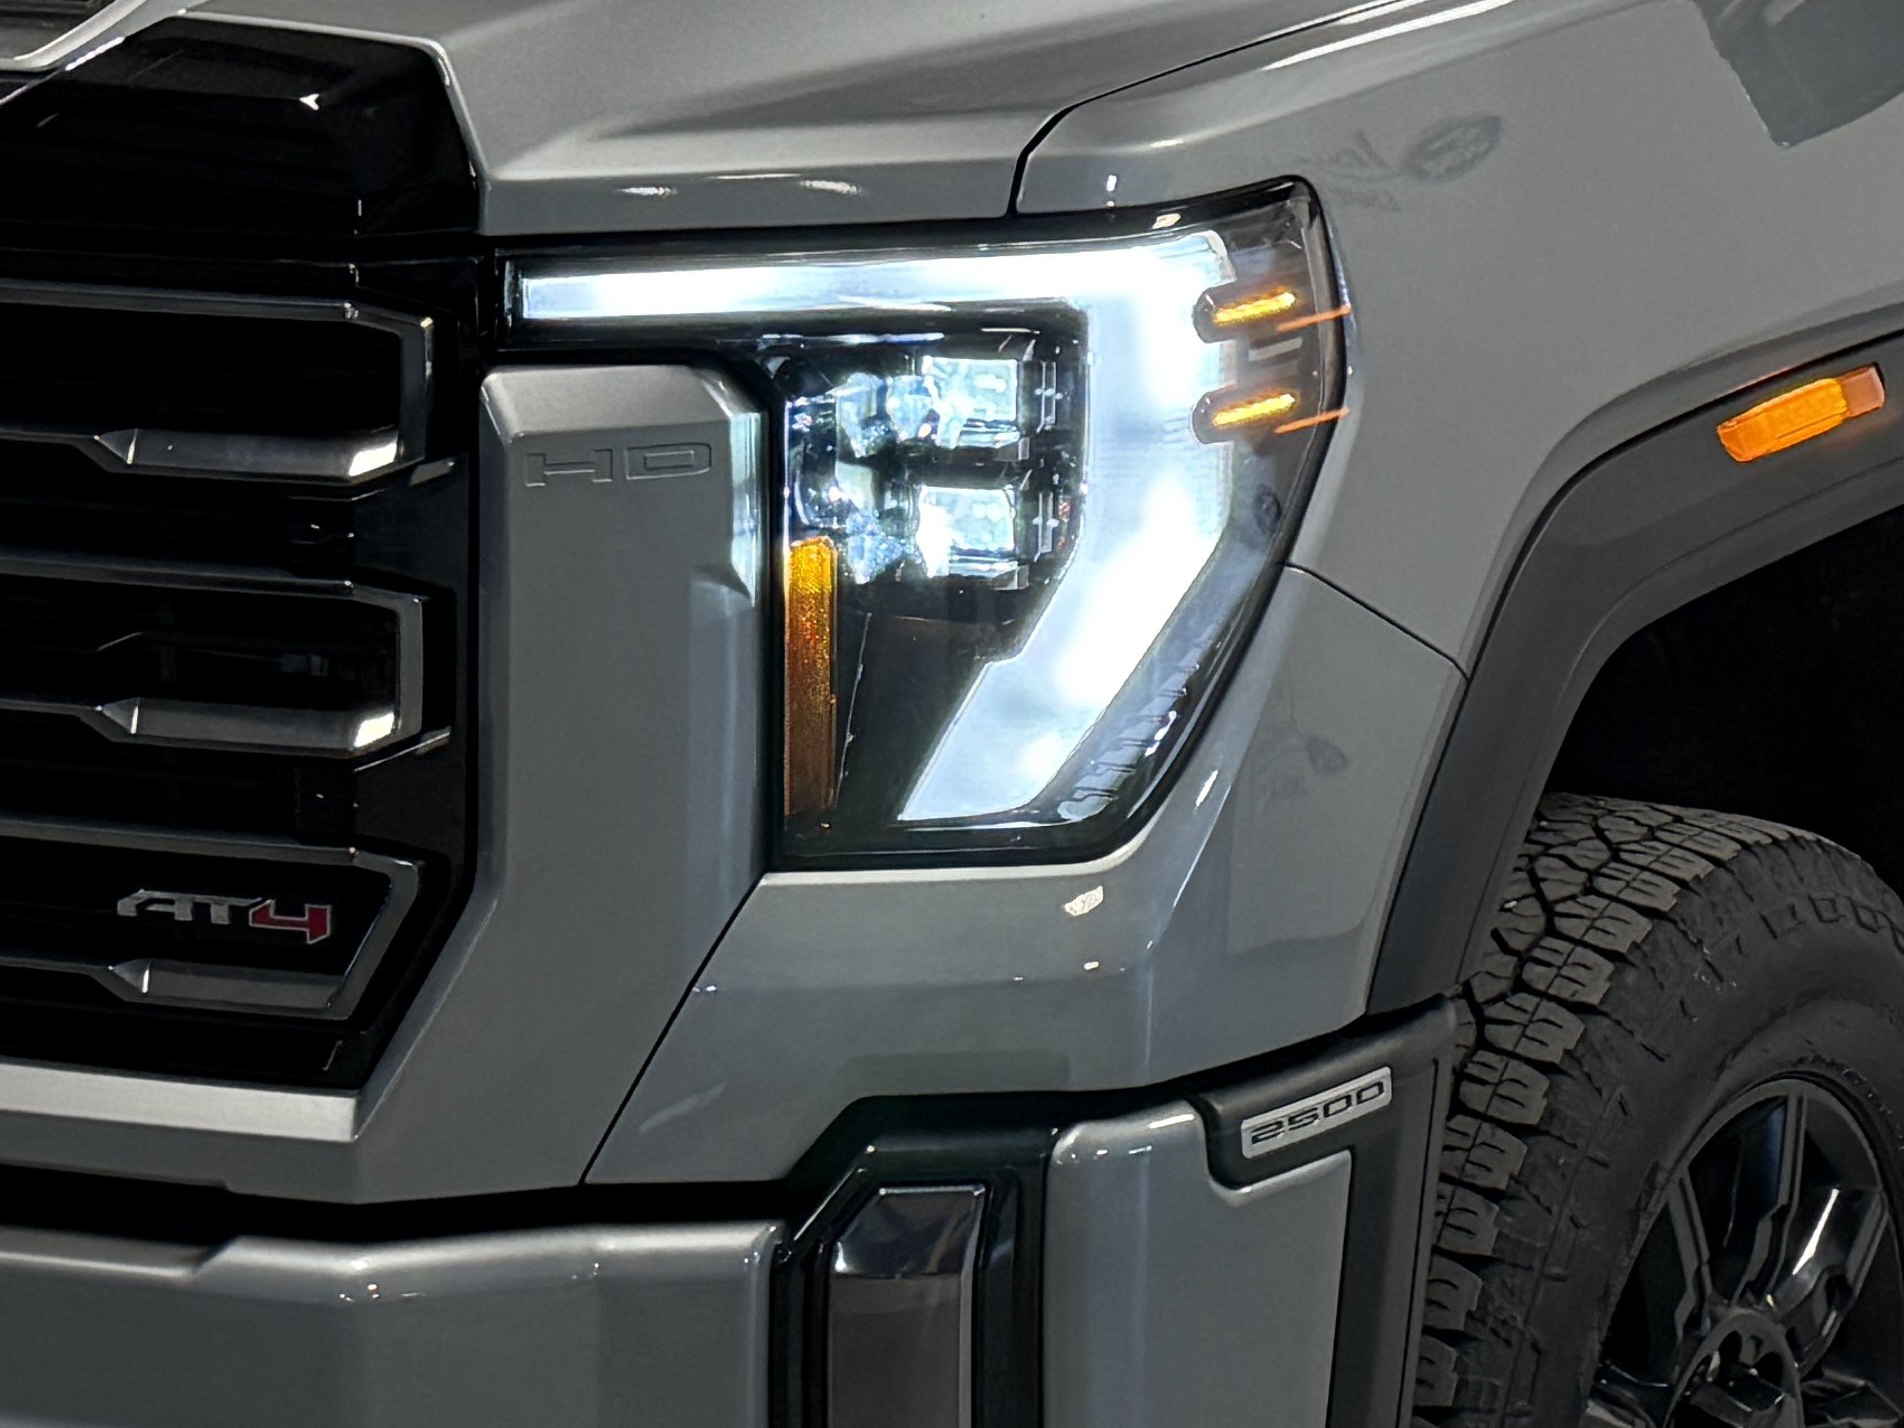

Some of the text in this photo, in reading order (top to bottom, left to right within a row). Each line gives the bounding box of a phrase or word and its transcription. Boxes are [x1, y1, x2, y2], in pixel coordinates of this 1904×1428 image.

[525, 443, 712, 488] HD
[117, 889, 333, 945] AT4
[1250, 1080, 1386, 1145] 2500
